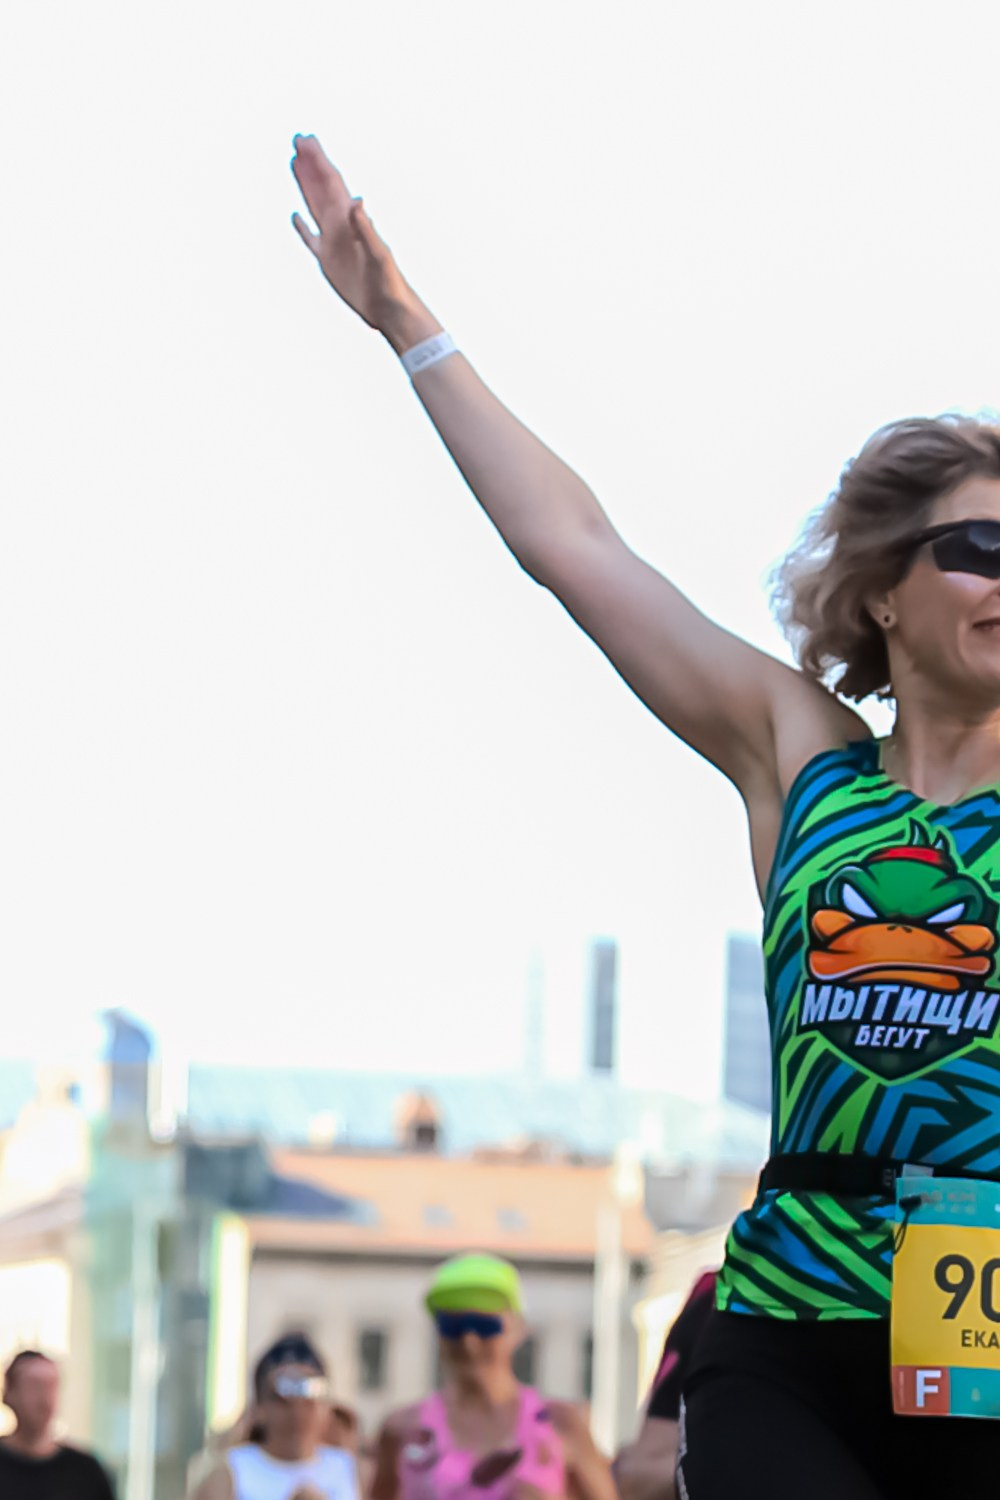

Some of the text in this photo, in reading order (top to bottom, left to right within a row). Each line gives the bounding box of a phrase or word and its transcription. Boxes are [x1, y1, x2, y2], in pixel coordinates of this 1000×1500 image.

[801, 983, 1000, 1035] МЫТИЩИ
[854, 1024, 931, 1049] БЕГУТ
[915, 1370, 942, 1408] F
